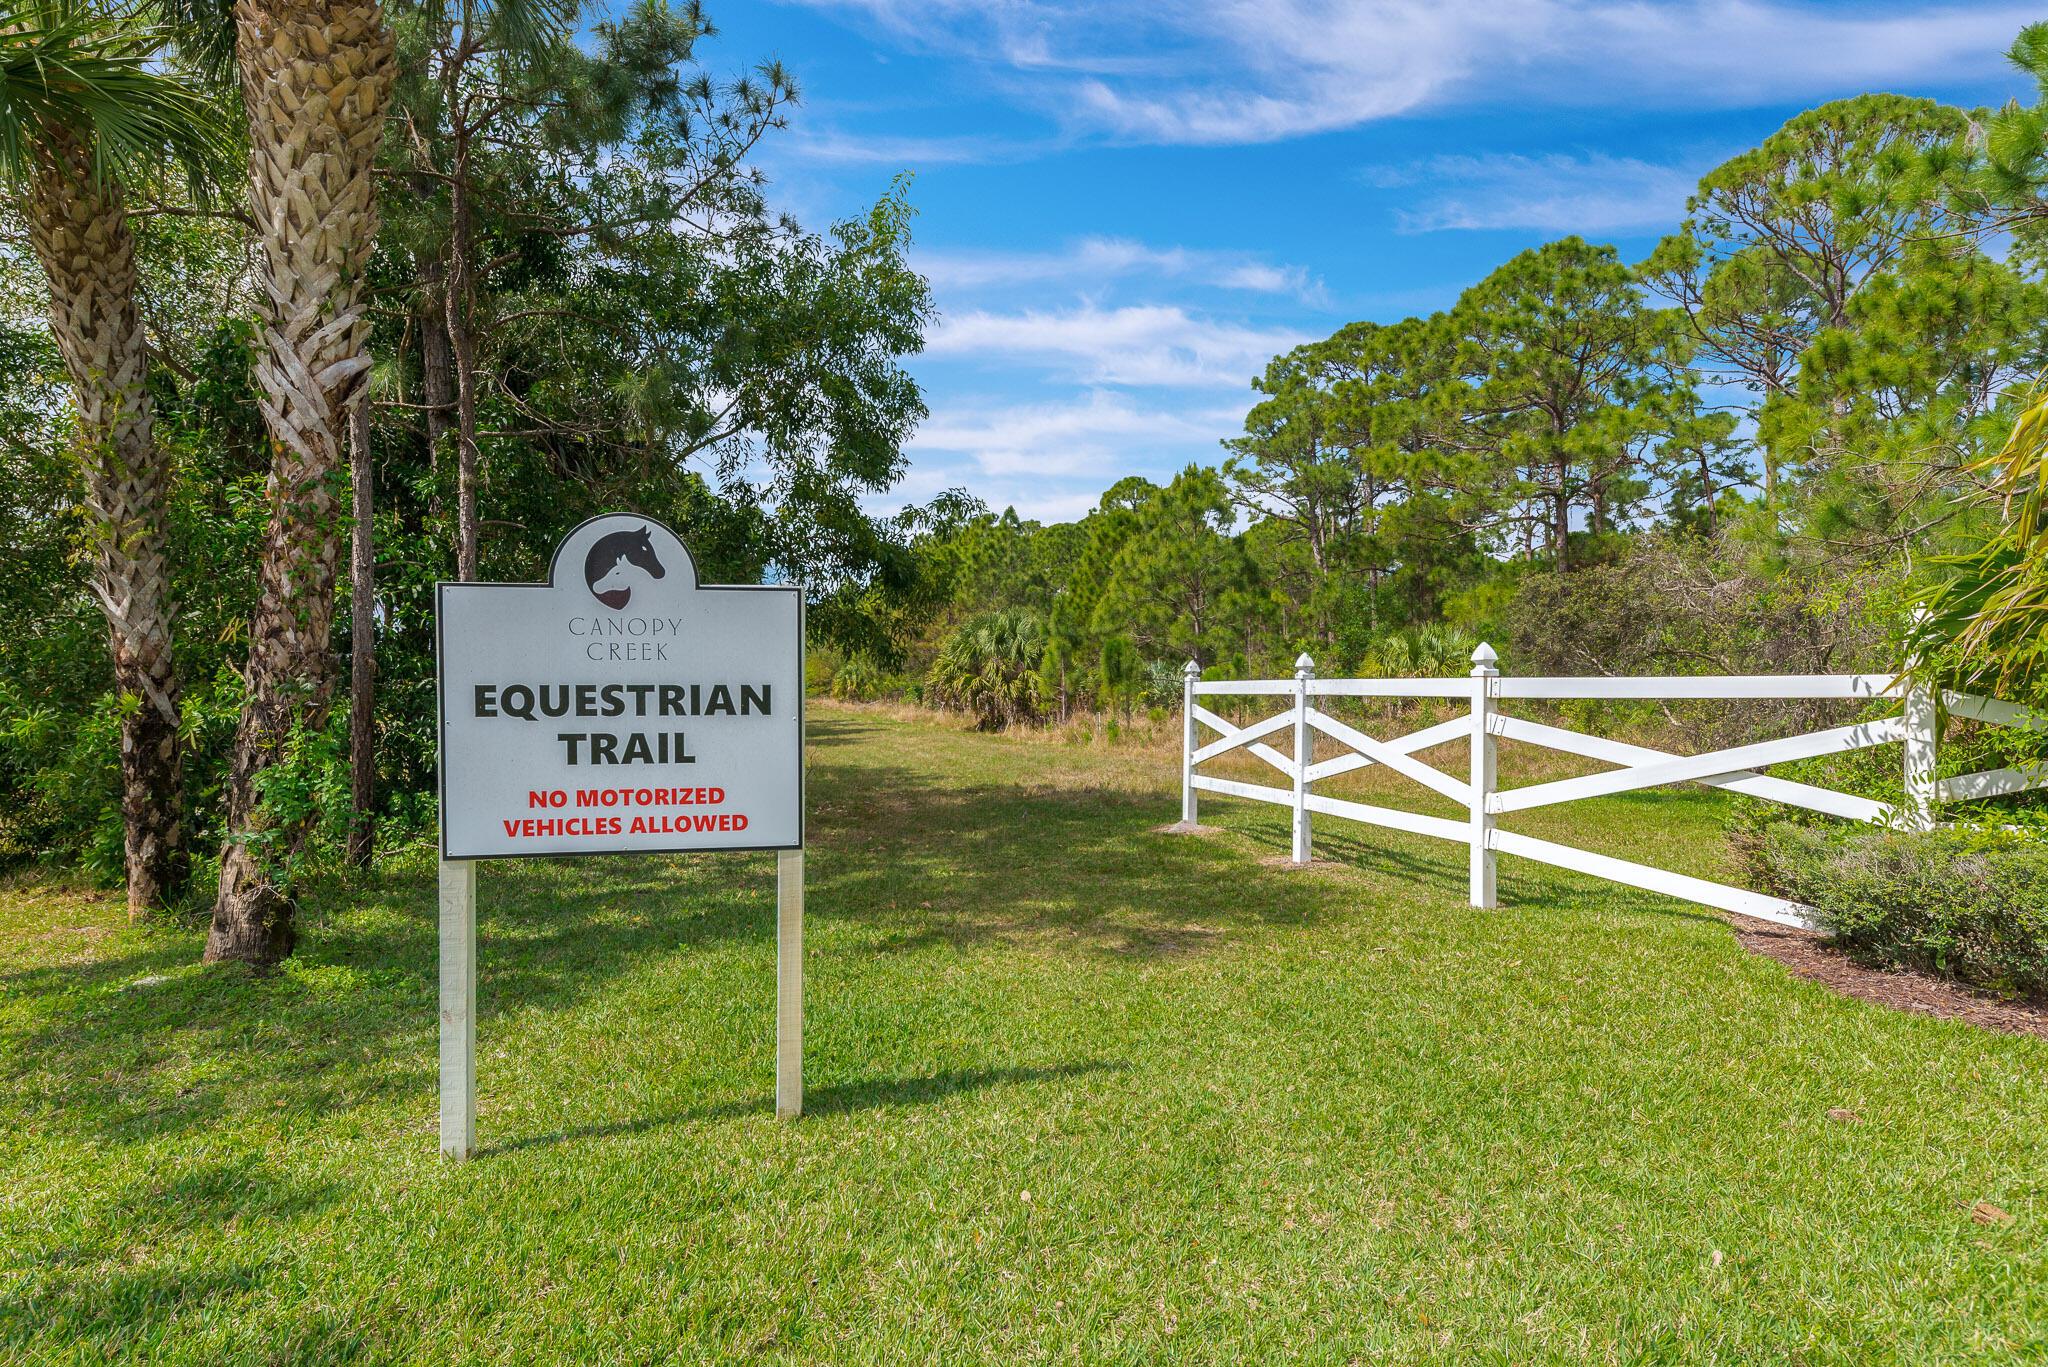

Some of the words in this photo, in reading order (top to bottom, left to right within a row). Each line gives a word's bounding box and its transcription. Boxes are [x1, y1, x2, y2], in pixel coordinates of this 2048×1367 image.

[568, 617, 682, 636] CANOPY
[586, 642, 668, 661] CREEK
[474, 684, 772, 721] EQUESTRIAN
[557, 732, 696, 765] TRAIL
[528, 790, 568, 808] NO
[575, 787, 725, 807] MOTORIZED
[503, 817, 622, 837] VEHICLES
[629, 814, 749, 834] ALLOWED
